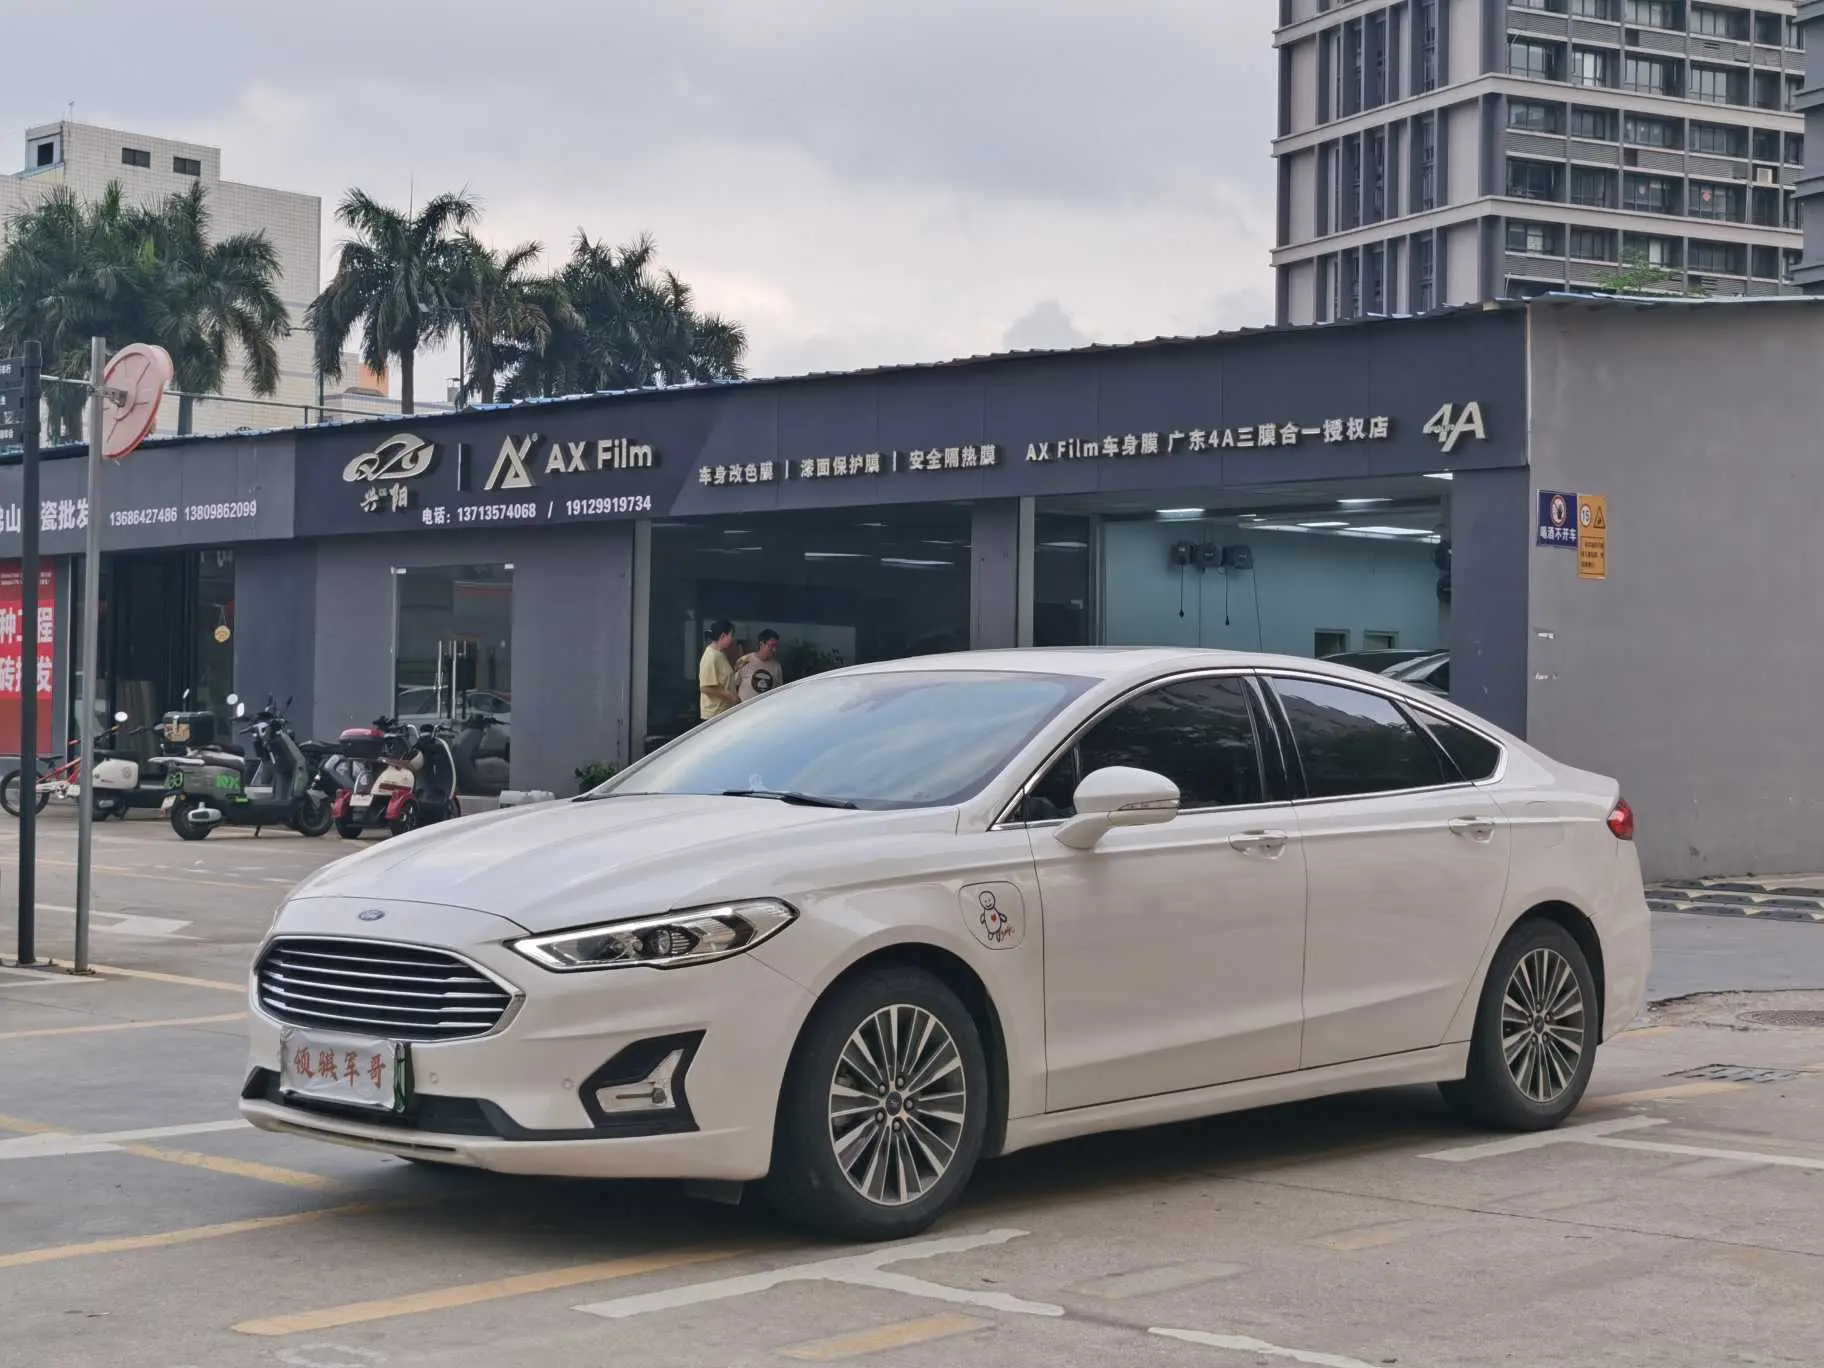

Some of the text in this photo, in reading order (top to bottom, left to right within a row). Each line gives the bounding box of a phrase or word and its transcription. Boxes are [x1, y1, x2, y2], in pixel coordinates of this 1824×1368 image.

[545, 437, 653, 473] AX Film
[1026, 441, 1050, 461] AX
[1167, 416, 1389, 453] 广东4A三膜合一授权店
[698, 444, 997, 486] 车身改色膜 漆面保护膜 安全隔热膜
[109, 507, 178, 527] 13686427486
[185, 499, 257, 522] 13809862099
[457, 502, 537, 522] 13713574068
[565, 495, 652, 516] 19129919734
